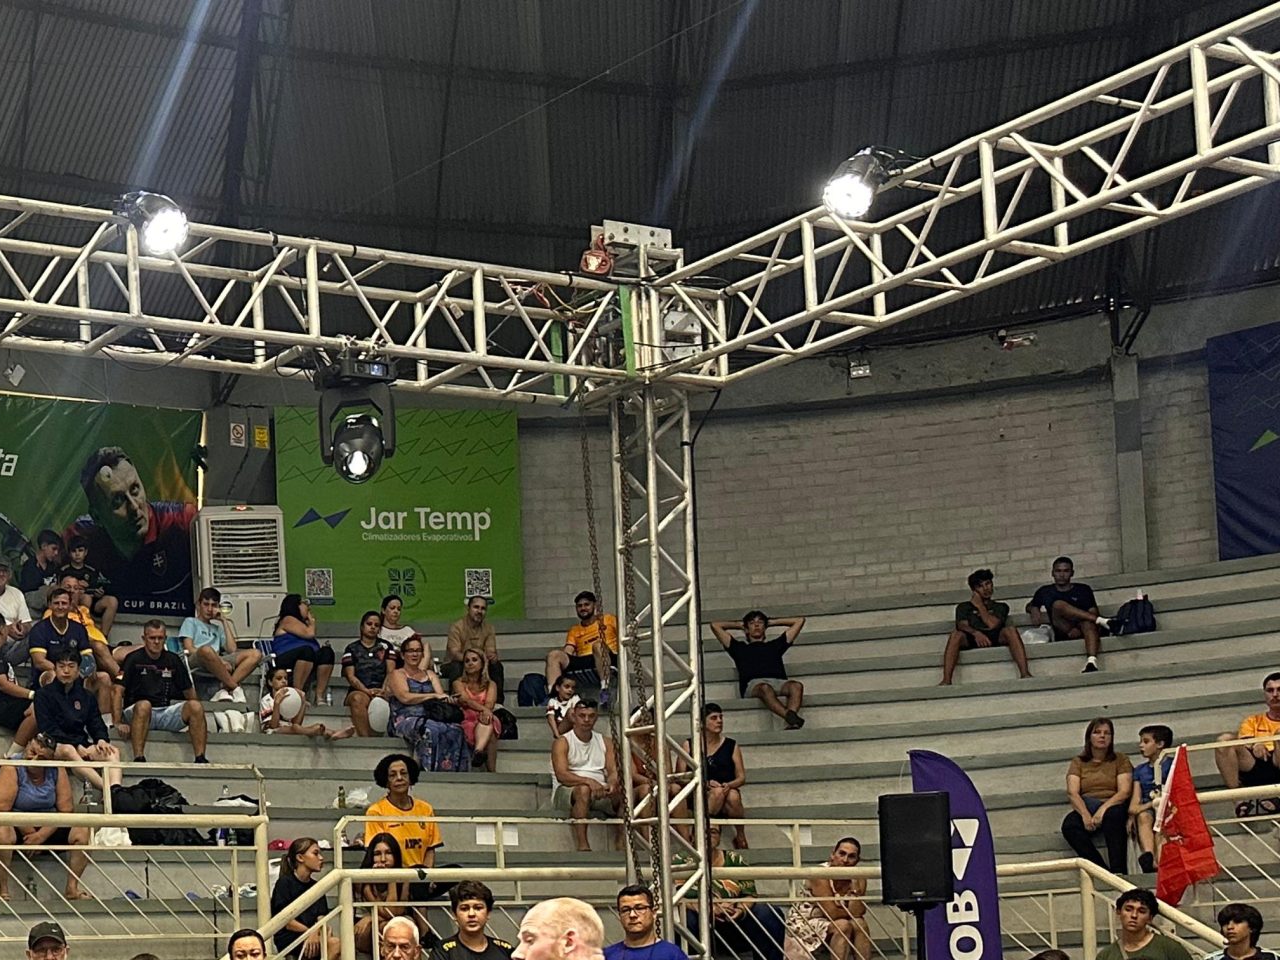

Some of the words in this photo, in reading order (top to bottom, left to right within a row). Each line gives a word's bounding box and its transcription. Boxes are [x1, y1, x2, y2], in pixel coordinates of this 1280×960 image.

[360, 507, 407, 530] Jar
[414, 507, 491, 541] Temp
[362, 532, 421, 542] Climatizadores
[422, 533, 474, 543] Evaporativos
[124, 600, 145, 608] CUP
[150, 601, 187, 610] BRAZIL
